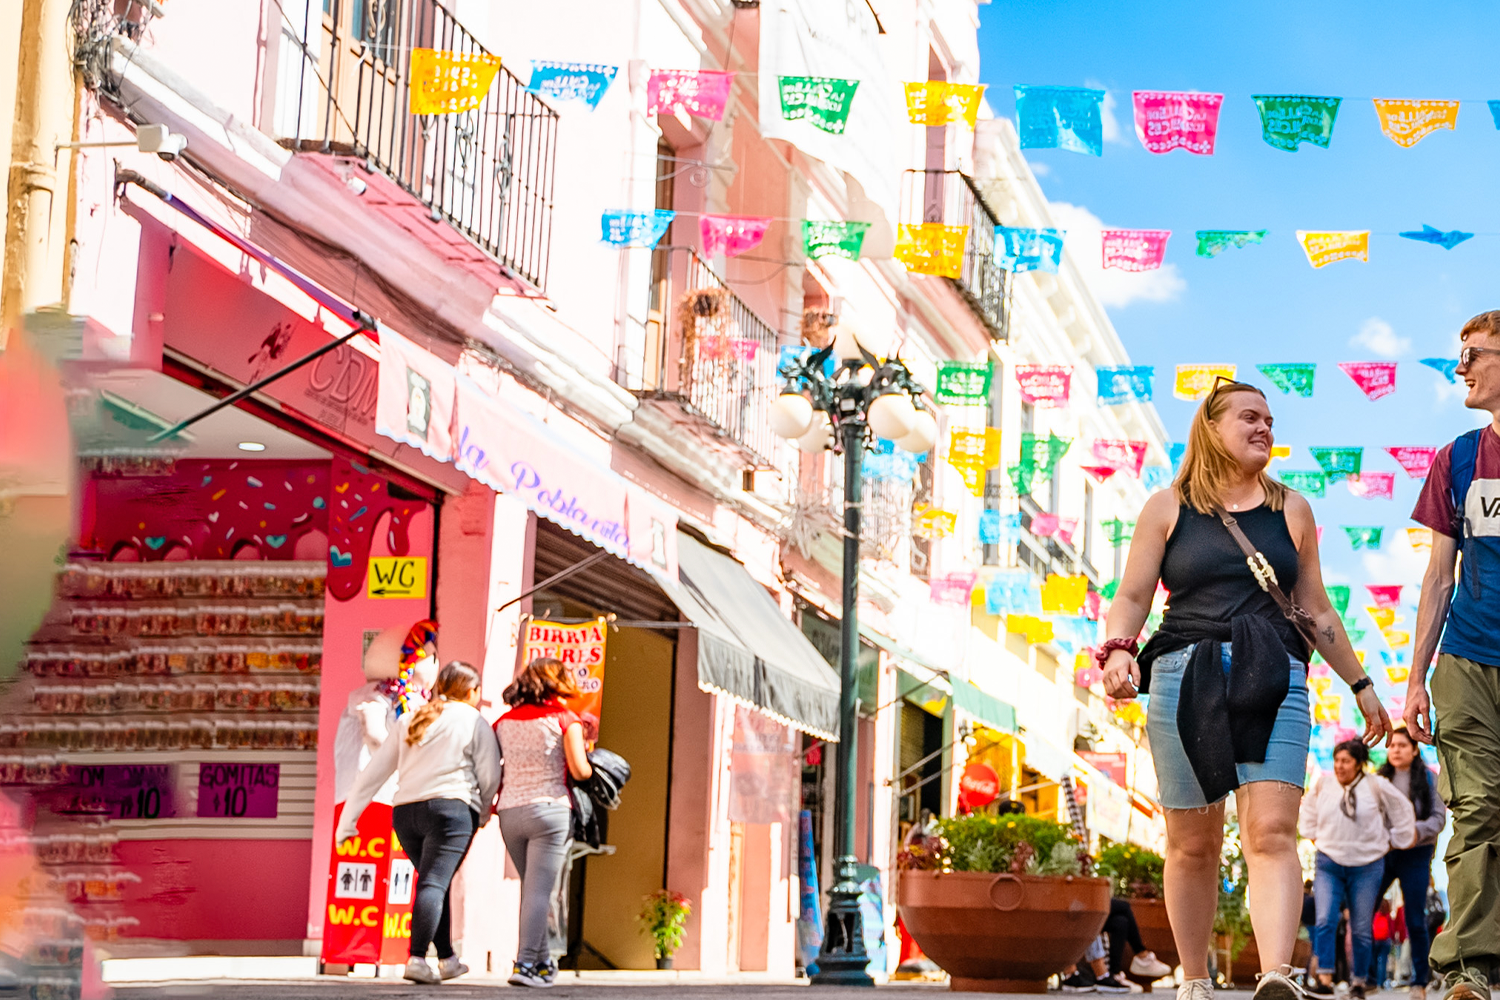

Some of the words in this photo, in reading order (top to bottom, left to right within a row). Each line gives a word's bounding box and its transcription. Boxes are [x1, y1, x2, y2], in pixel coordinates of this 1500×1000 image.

[458, 426, 489, 470] la
[510, 461, 632, 548] Poblanita
[374, 560, 415, 588] WC
[529, 627, 602, 644] BIRRIA
[562, 647, 602, 664] RES
[200, 765, 278, 787] GOMITAS
[328, 904, 379, 927] W.C
